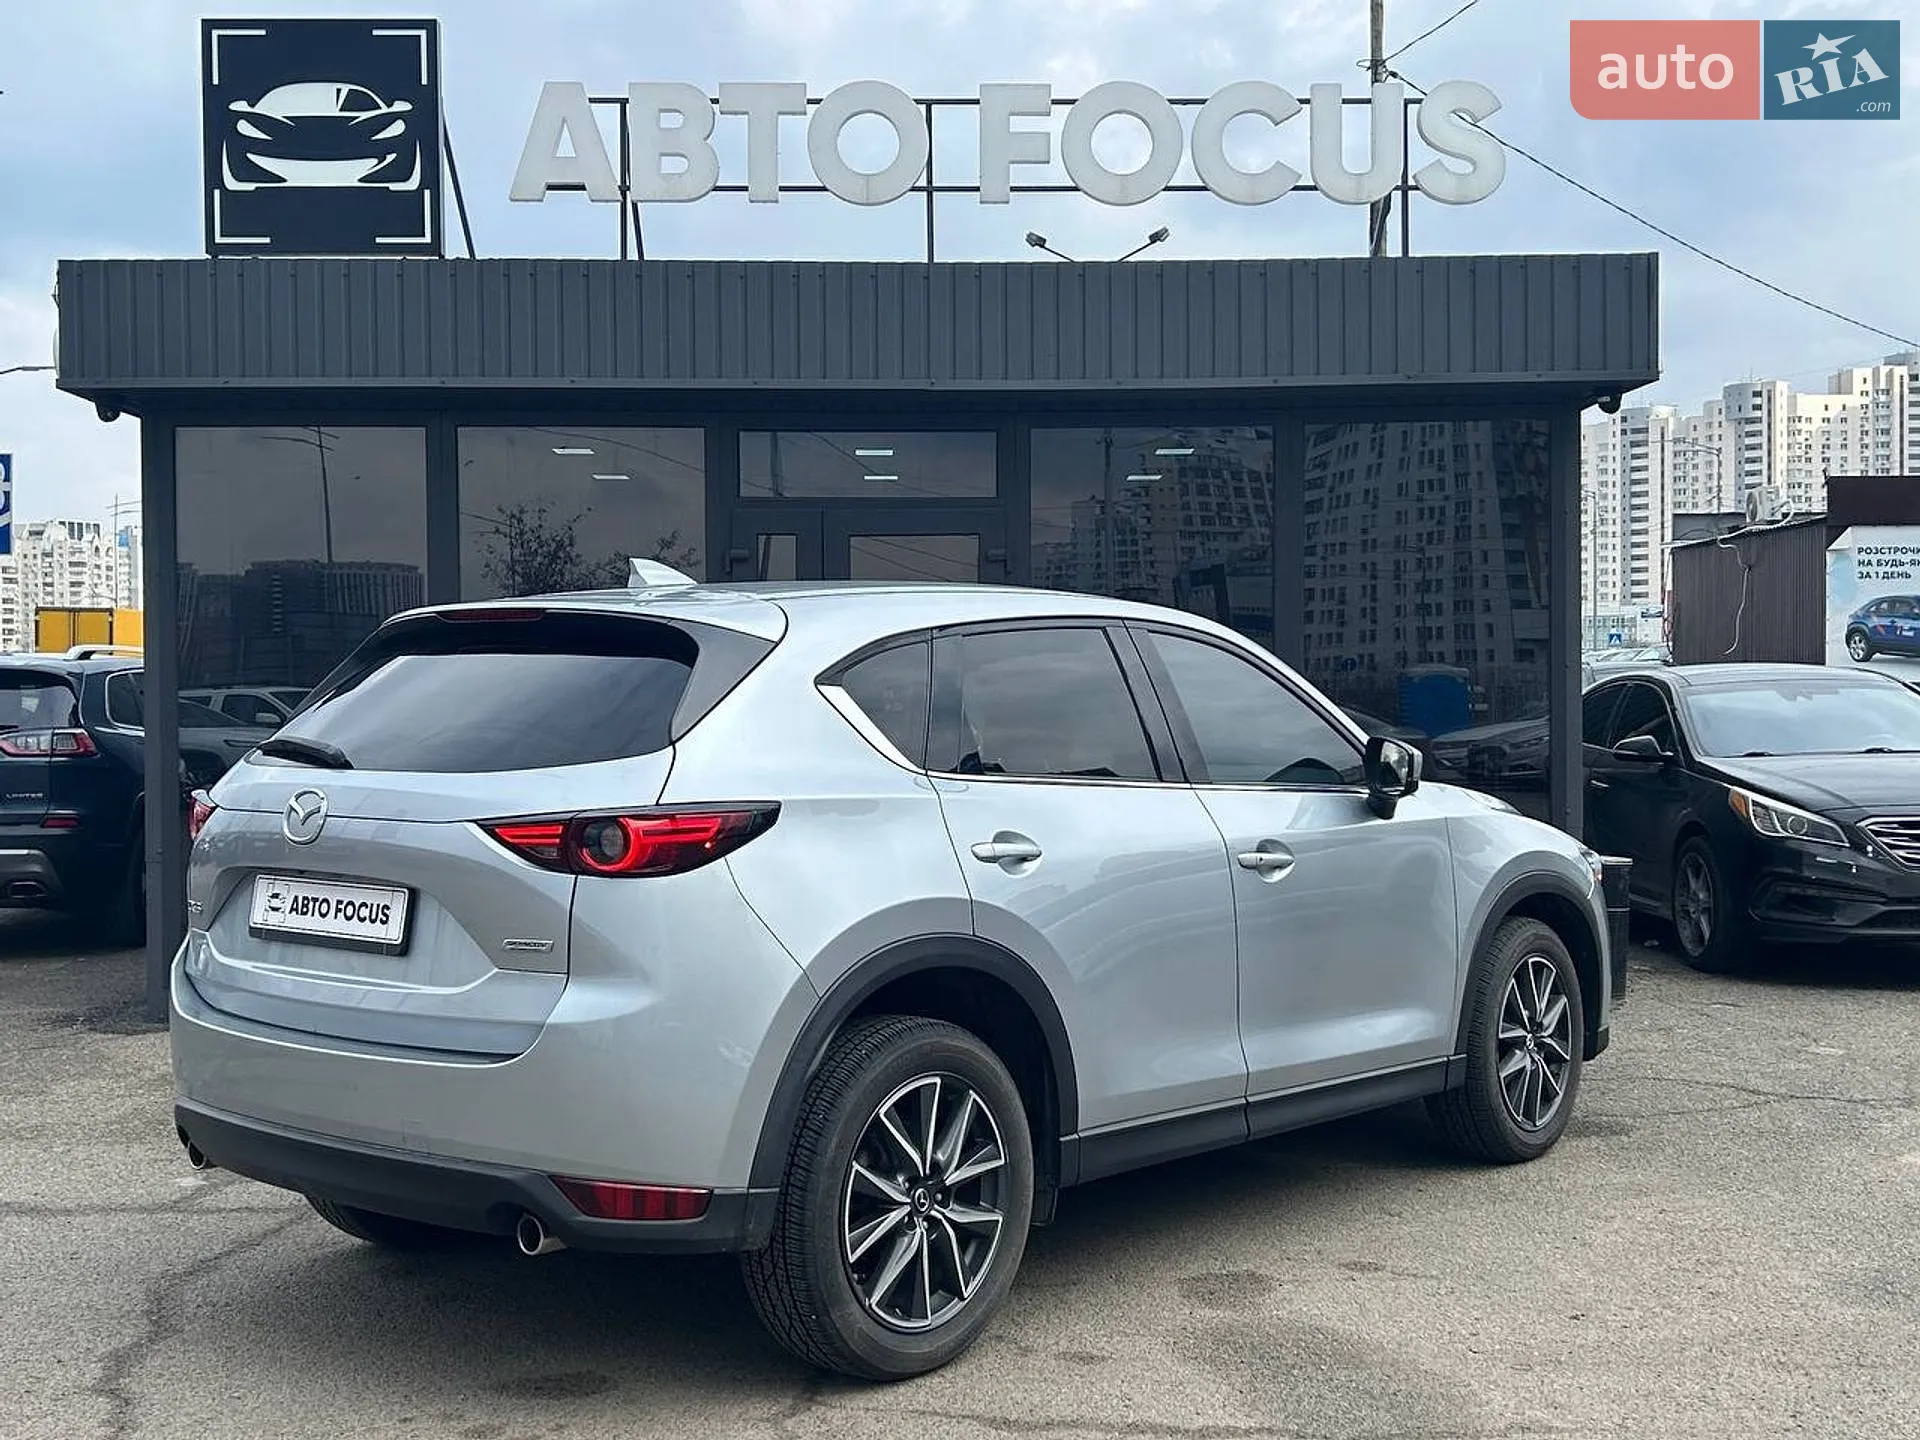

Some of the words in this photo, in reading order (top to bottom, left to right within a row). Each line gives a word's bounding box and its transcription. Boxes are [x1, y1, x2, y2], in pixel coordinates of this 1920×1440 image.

[509, 80, 930, 206] АВТО
[979, 81, 1507, 206] FOCUS
[1858, 559, 1873, 567] НА
[1857, 571, 1872, 579] ЗА
[1882, 571, 1912, 580] ДЕНЬ
[288, 895, 331, 919] АВТО
[334, 899, 391, 926] FOCUS
